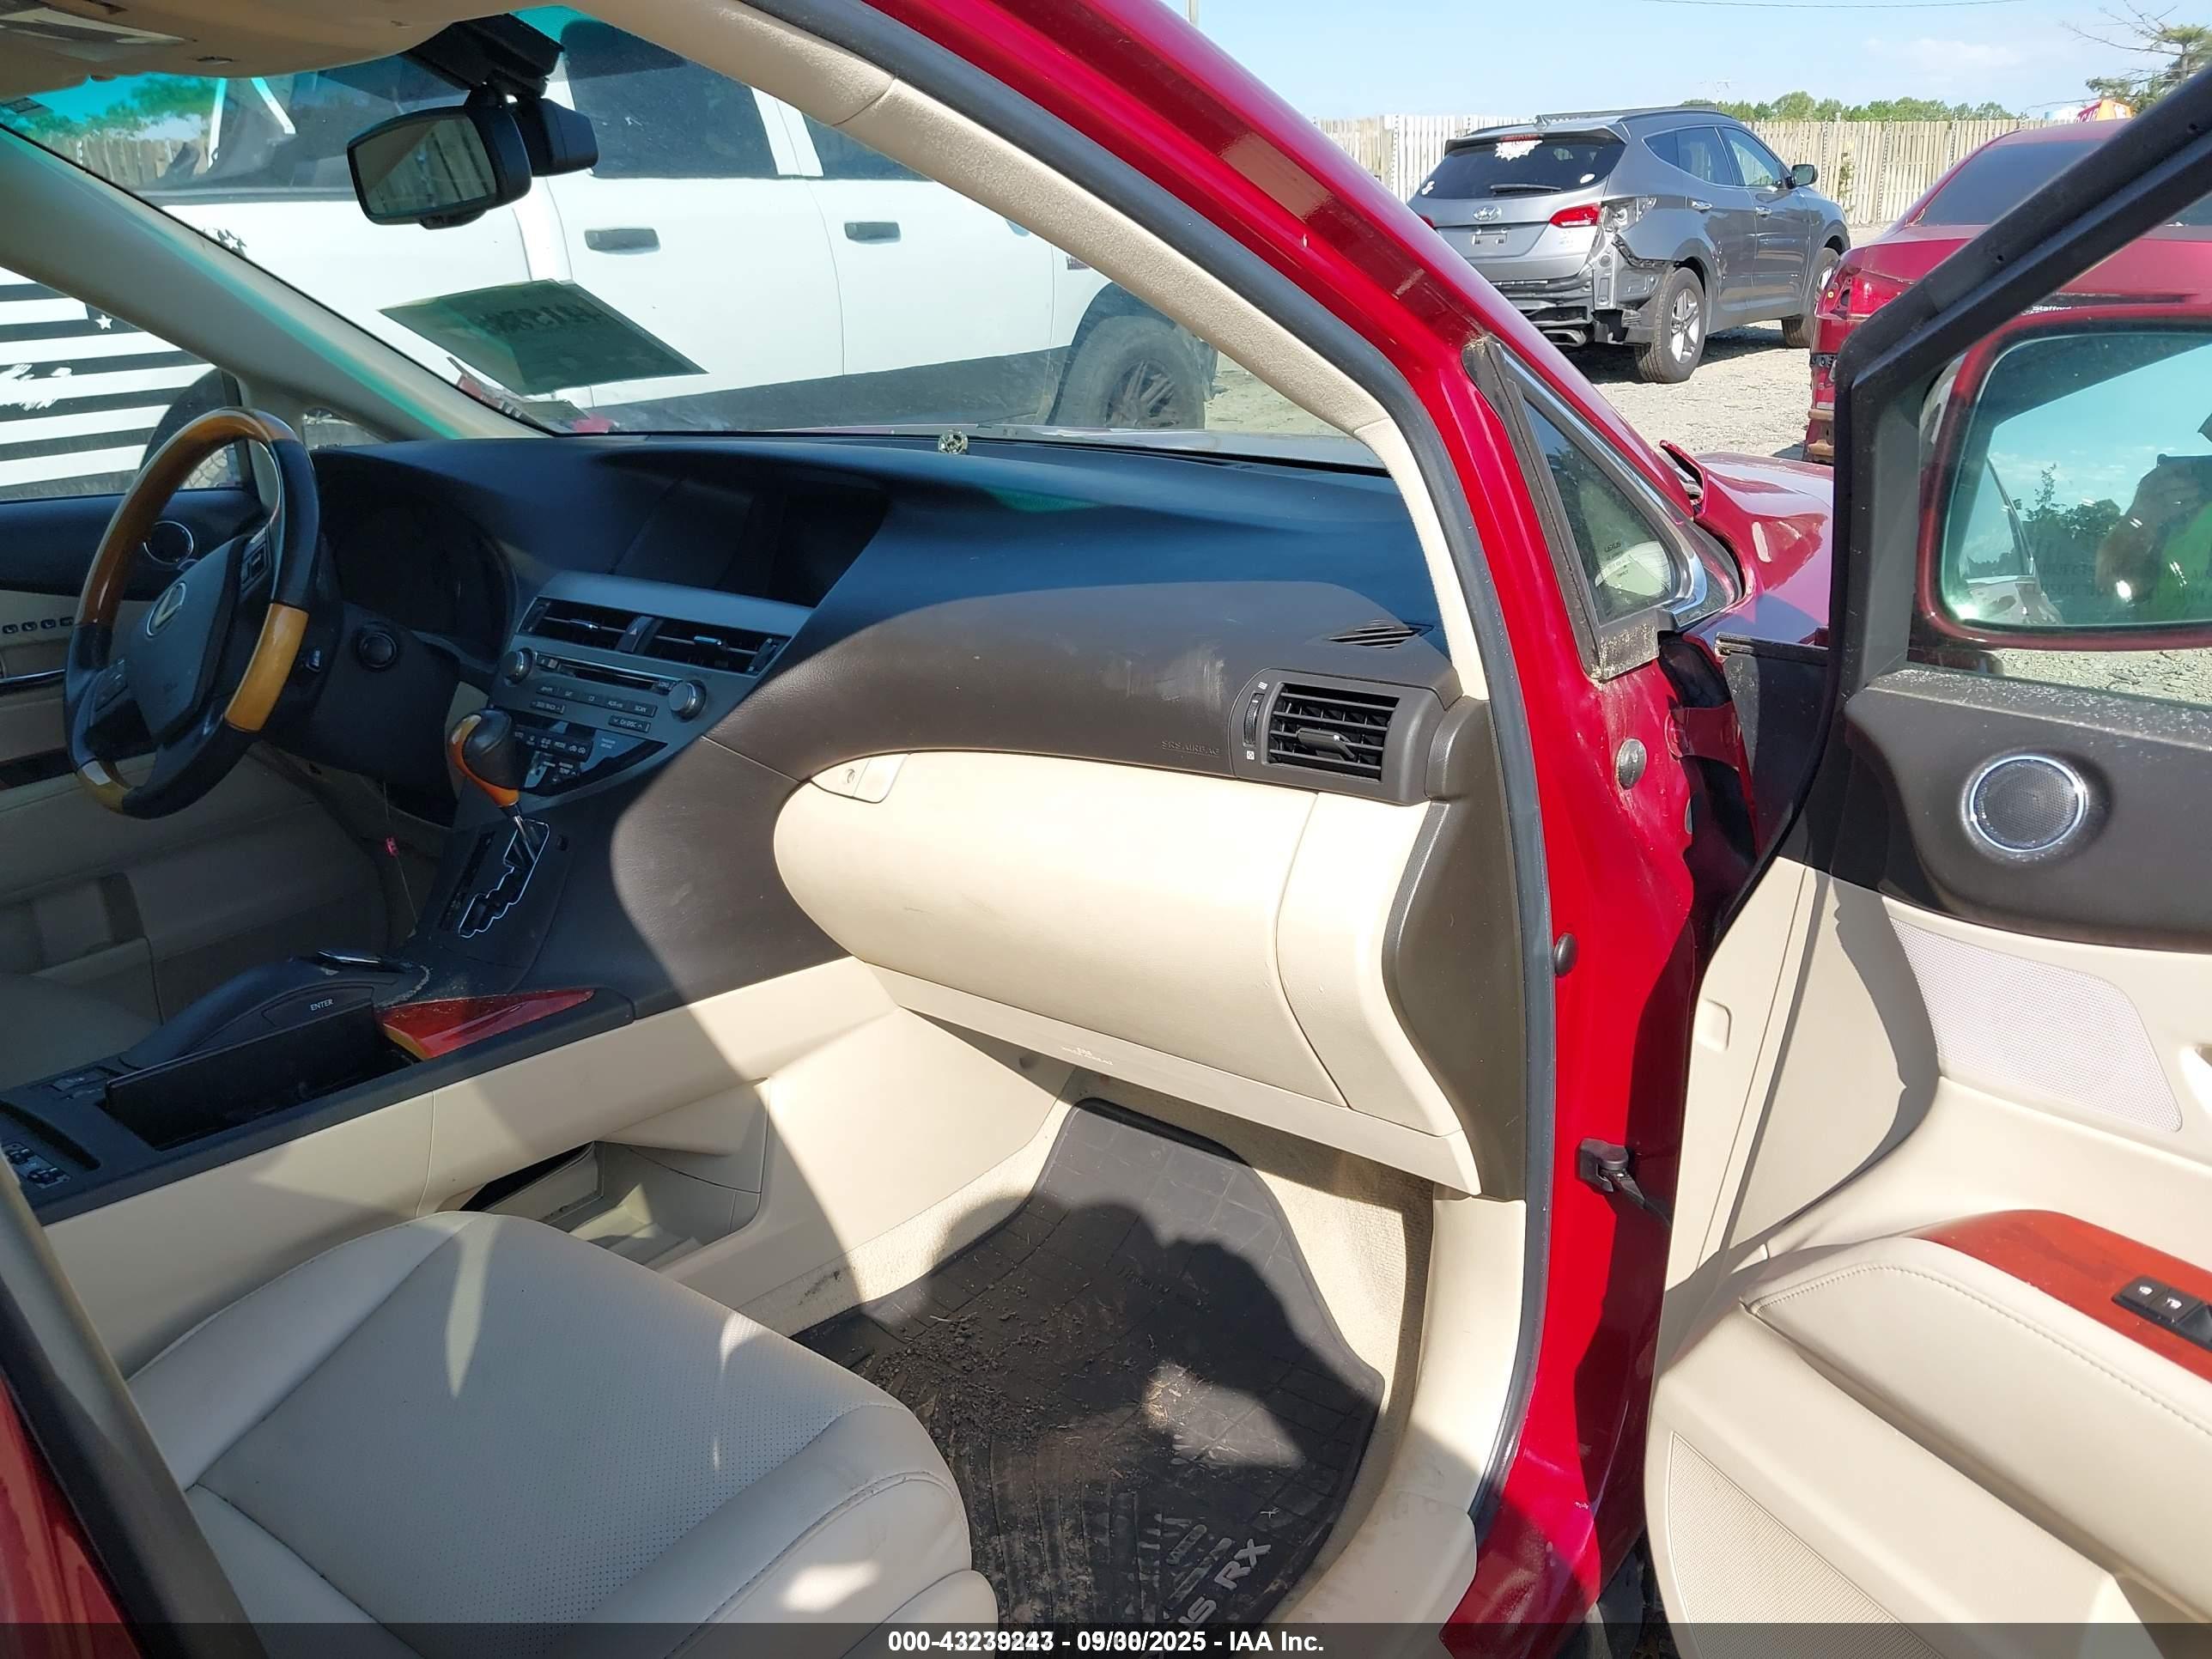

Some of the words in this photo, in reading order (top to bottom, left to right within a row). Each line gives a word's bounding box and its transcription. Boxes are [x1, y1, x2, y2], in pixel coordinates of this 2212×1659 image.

[1161, 740, 1181, 750] SRS
[310, 999, 333, 1012] ENTER
[1214, 1538, 1272, 1589] RX
